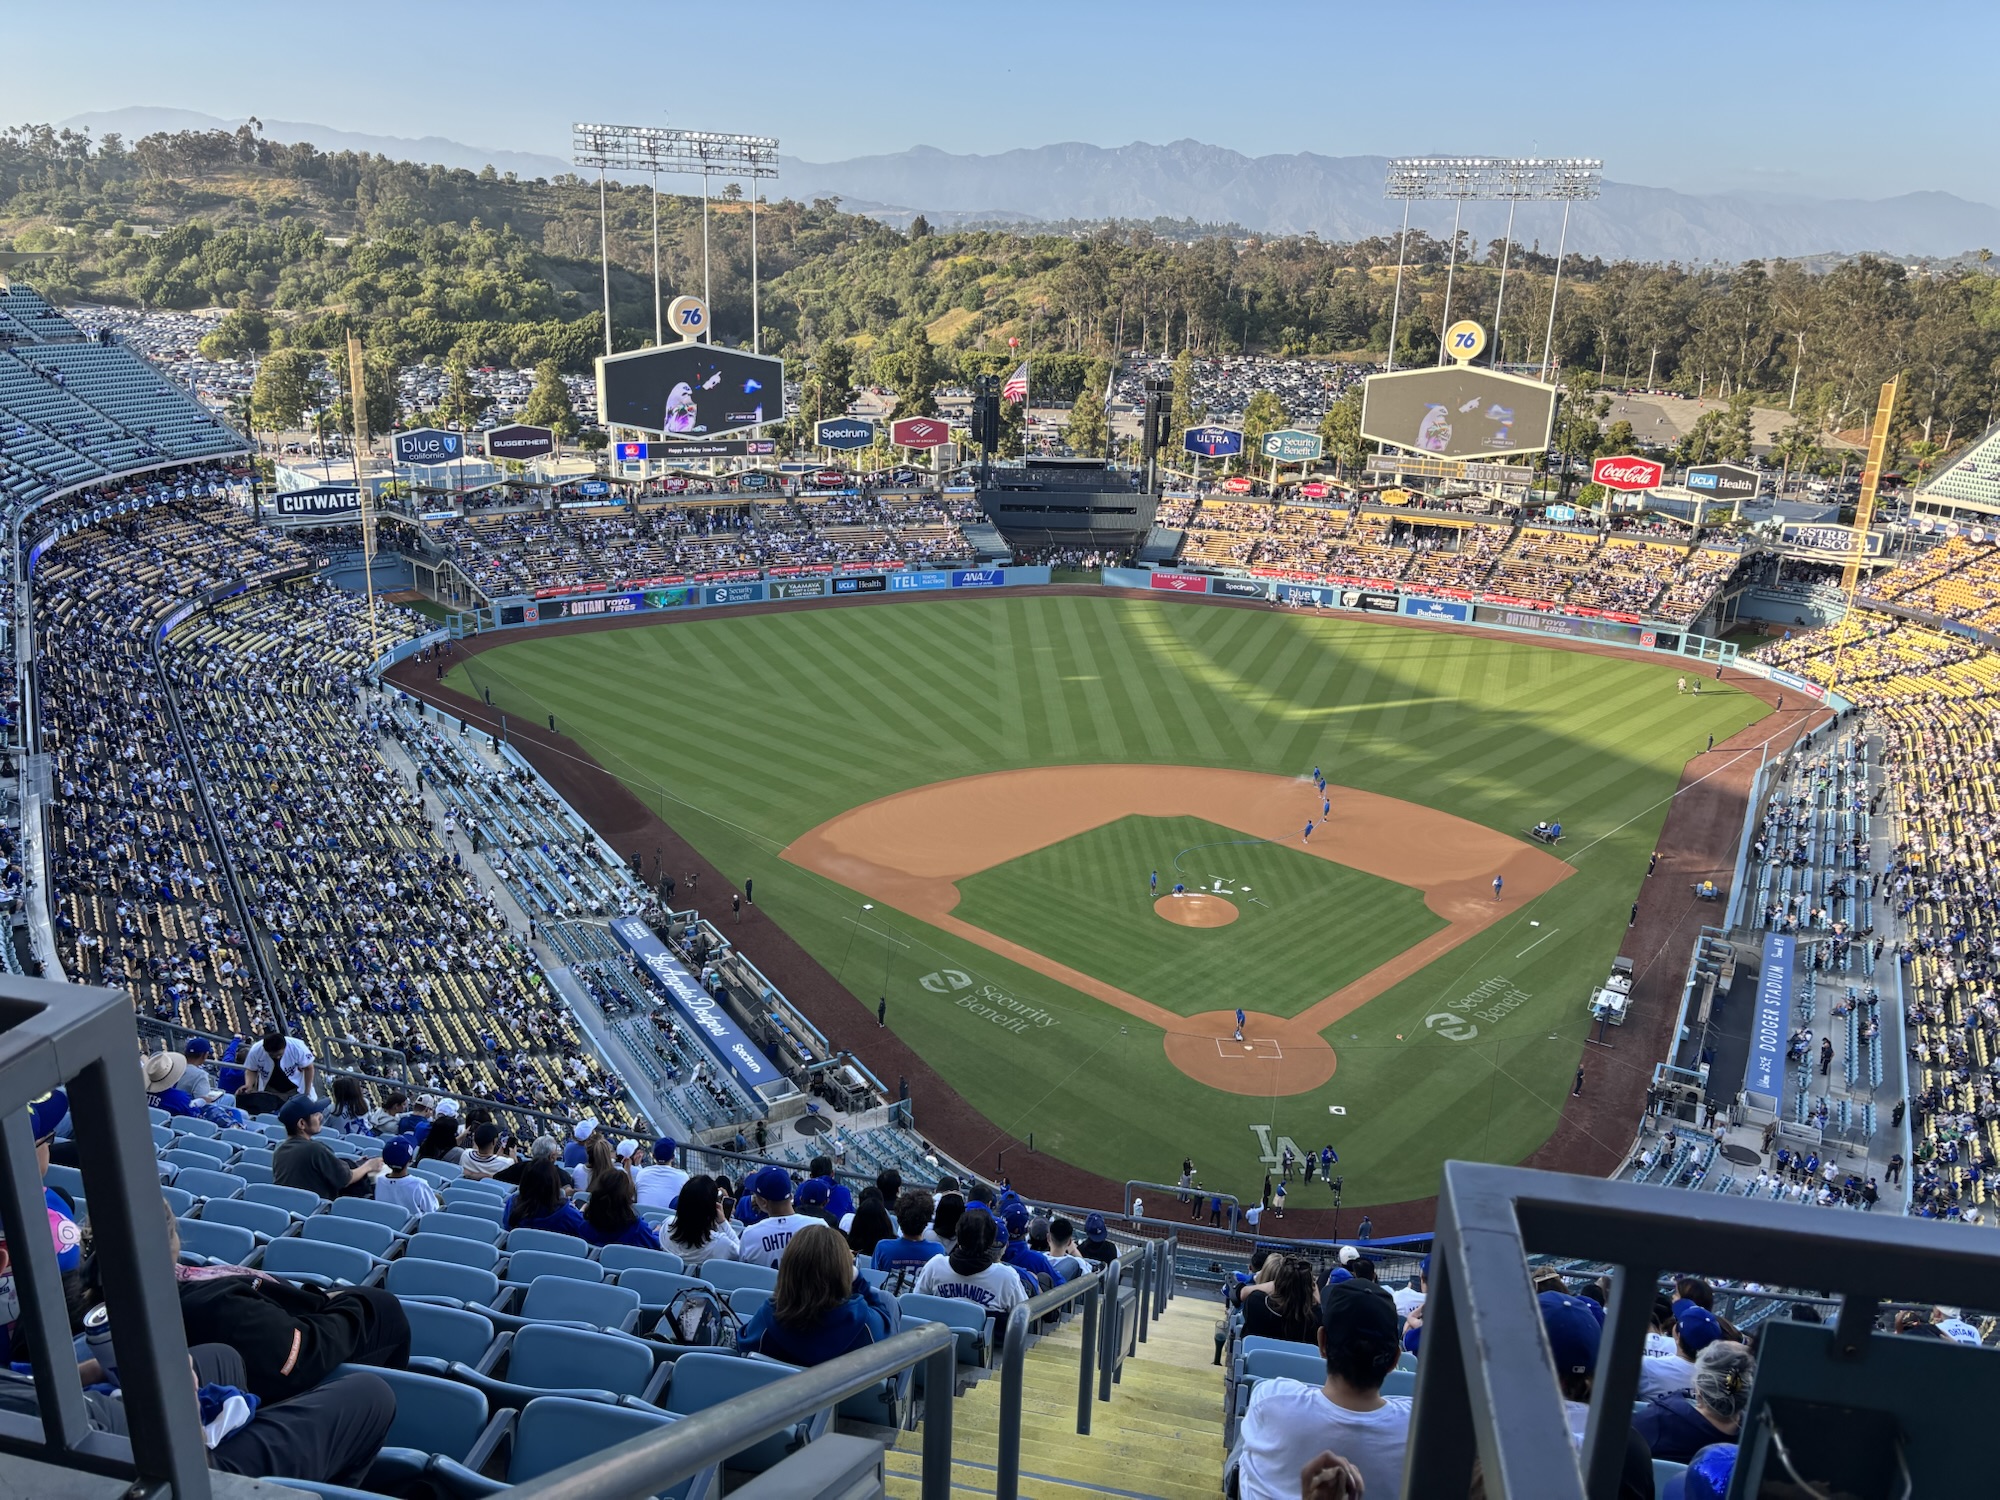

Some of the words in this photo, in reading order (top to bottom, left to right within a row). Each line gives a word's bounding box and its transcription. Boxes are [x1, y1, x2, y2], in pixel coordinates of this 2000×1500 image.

[682, 308, 702, 325] 76
[1454, 332, 1476, 348] 76
[822, 428, 866, 440] Spectrum
[1196, 434, 1230, 444] ULTRA
[402, 437, 440, 454] blue
[494, 438, 548, 448] GUGGENHEIM
[1284, 438, 1316, 448] Security
[1284, 446, 1312, 455] Benefit
[1478, 470, 1484, 478] 0
[1486, 470, 1491, 478] 0
[1493, 471, 1499, 479] 0
[1598, 462, 1654, 485] Coca-Cola
[666, 478, 685, 488] JINRO
[1691, 476, 1714, 488] UCLA
[1719, 478, 1752, 491] Health
[1549, 507, 1572, 520] TEL
[1789, 535, 1852, 550] JALISCO
[858, 578, 882, 588] Health
[893, 575, 918, 588] TEL
[962, 572, 983, 582] ANA
[729, 586, 753, 595] Security
[1225, 582, 1255, 592] Spectrum
[1288, 588, 1311, 598] blue
[571, 600, 606, 615] OHTANI
[606, 598, 630, 607] TOYO
[610, 603, 636, 612] TIRES
[526, 610, 537, 619] 76
[1417, 608, 1455, 619] Budweiser
[1506, 612, 1540, 628] OHTANI
[1541, 618, 1567, 628] TOYO
[1544, 625, 1572, 634] TIRES
[1764, 965, 1784, 1006] STADIUM
[1447, 975, 1515, 1013] Security
[975, 985, 1060, 1028] Security
[1472, 988, 1533, 1024] Benefit
[688, 997, 730, 1037] Dodgers
[954, 994, 1030, 1034] Benefit
[1759, 1008, 1780, 1052] DODGER
[732, 1043, 760, 1072] Spectrum
[1249, 1124, 1322, 1175] LA
[762, 1232, 792, 1252] OHTA
[937, 1282, 996, 1307] HERNANDEZ
[1948, 1328, 1976, 1339] OHTANI
